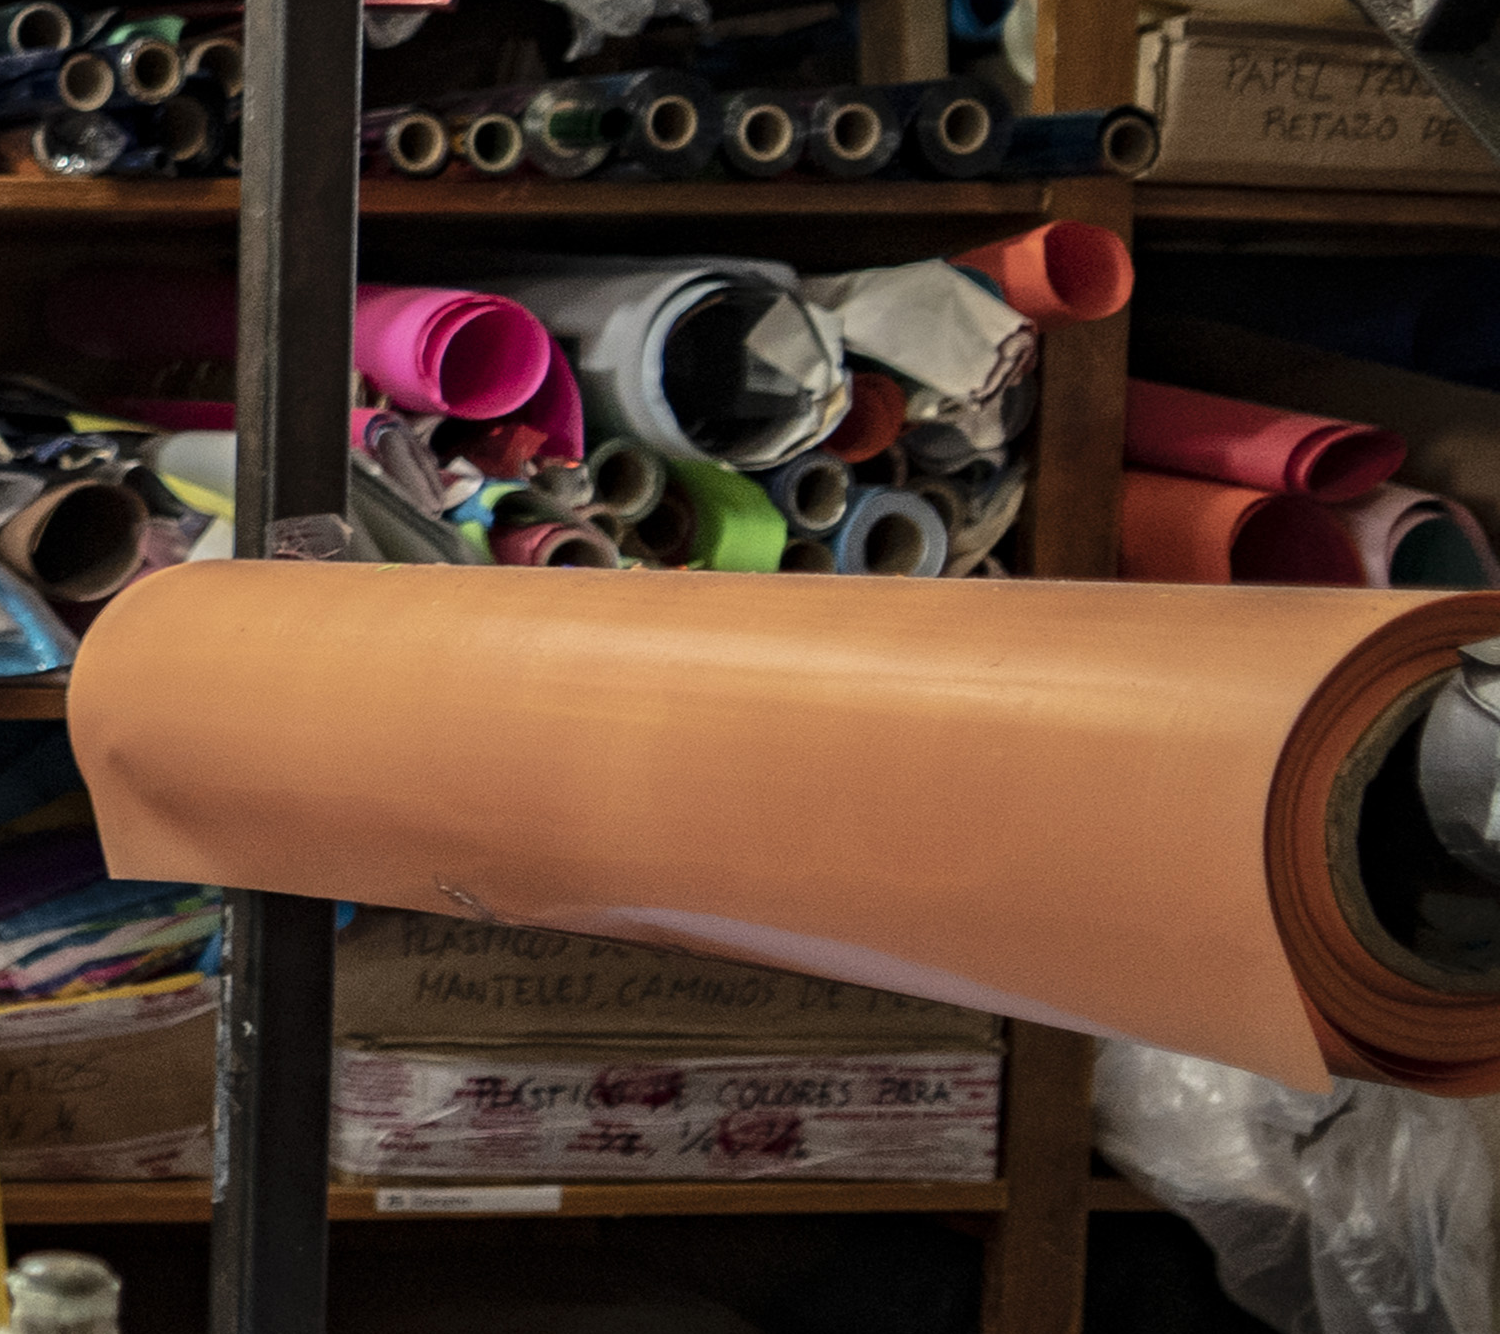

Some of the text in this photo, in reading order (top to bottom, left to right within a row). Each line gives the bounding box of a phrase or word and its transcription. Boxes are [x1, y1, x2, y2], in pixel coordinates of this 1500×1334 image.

[1227, 51, 1330, 102] PAPEL
[714, 1075, 853, 1108] COLORES
[874, 1074, 953, 1107] PARA
